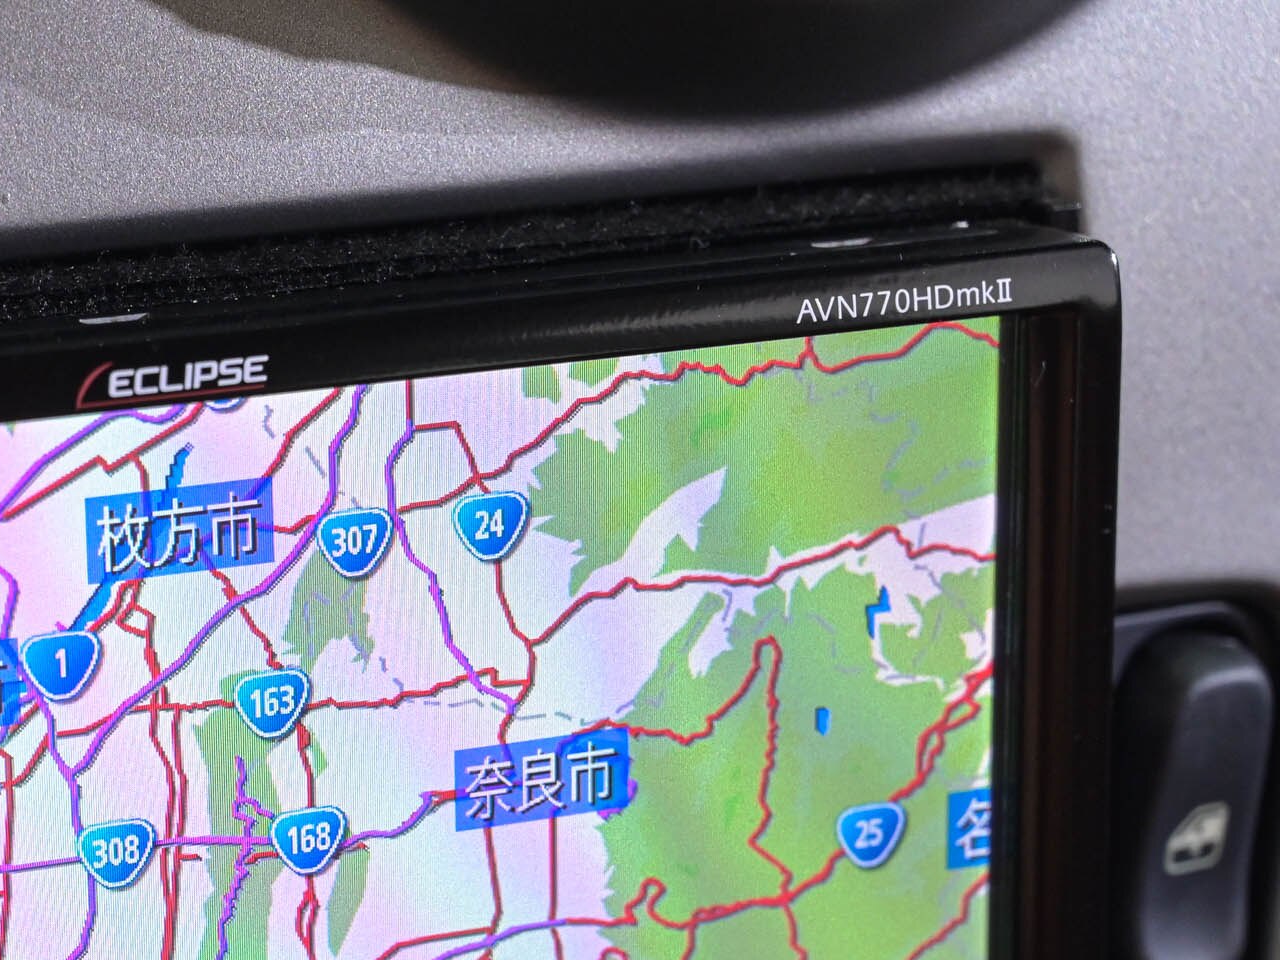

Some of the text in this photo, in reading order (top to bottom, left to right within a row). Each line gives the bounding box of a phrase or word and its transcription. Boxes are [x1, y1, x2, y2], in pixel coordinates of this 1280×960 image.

[107, 355, 269, 399] ECLIPSE
[96, 490, 261, 574] 枚方市
[473, 503, 506, 537] 24
[330, 523, 377, 560] 307
[55, 645, 69, 680] 1
[249, 683, 297, 719] 163
[463, 740, 615, 822] 奈良市
[285, 827, 332, 864] 168
[856, 812, 885, 846] 25
[91, 834, 141, 872] 308
